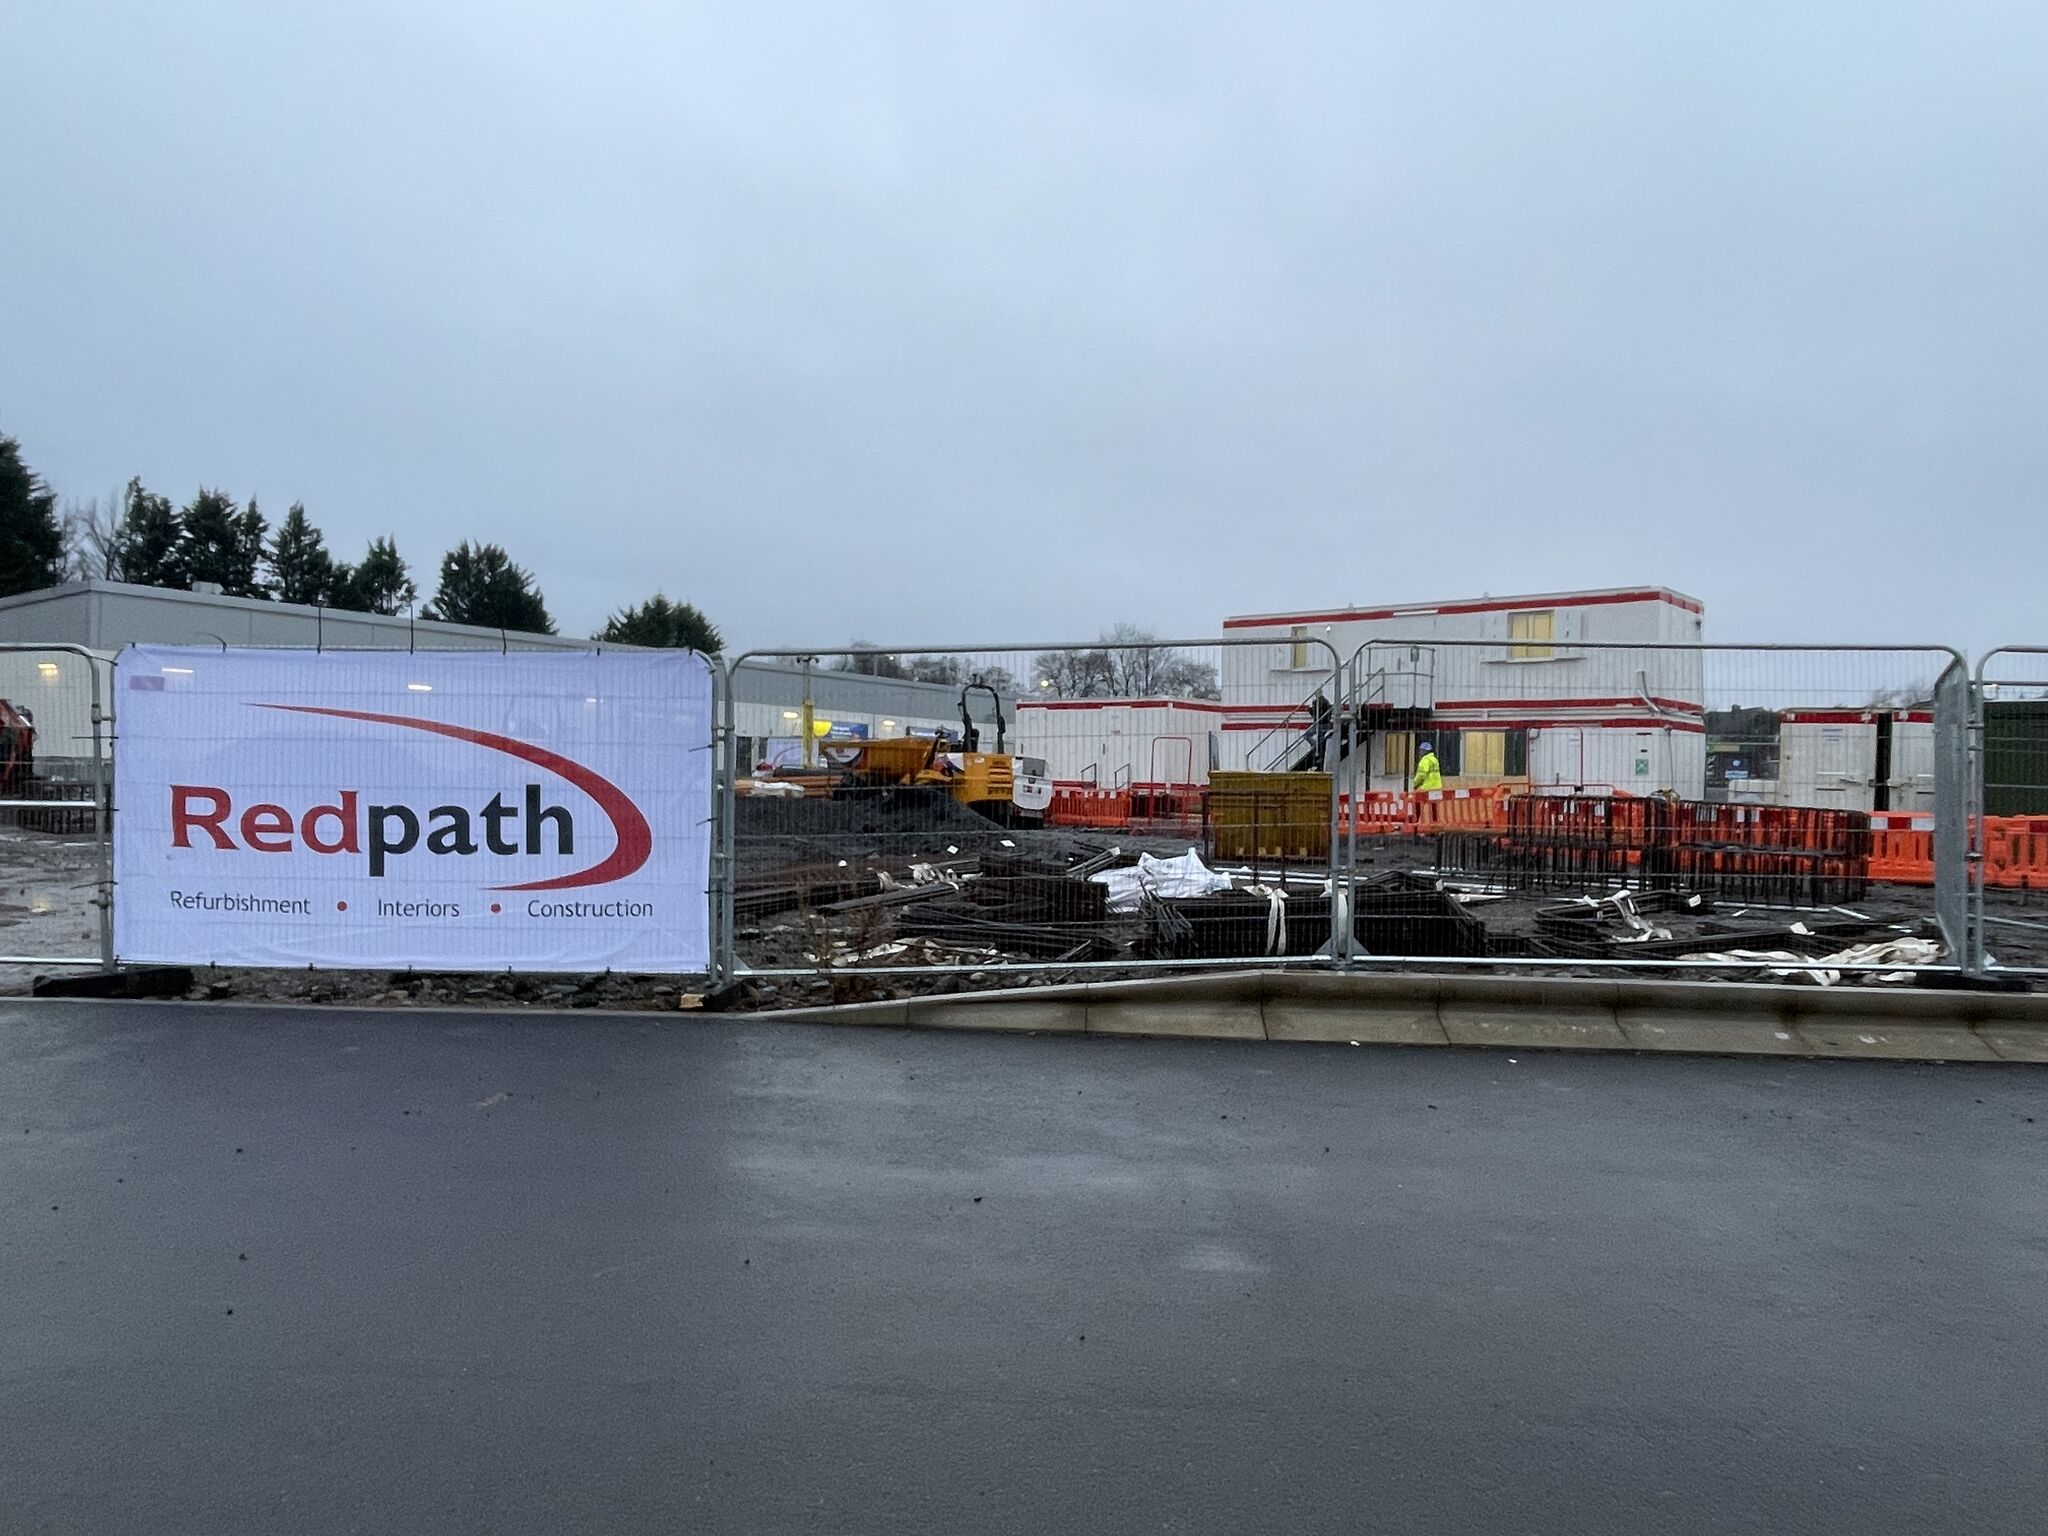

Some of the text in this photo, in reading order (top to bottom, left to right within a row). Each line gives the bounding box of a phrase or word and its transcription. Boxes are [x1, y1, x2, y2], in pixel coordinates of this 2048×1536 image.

[169, 783, 575, 878] Redpath
[170, 890, 653, 918] Refurbishment Interiors Construction
